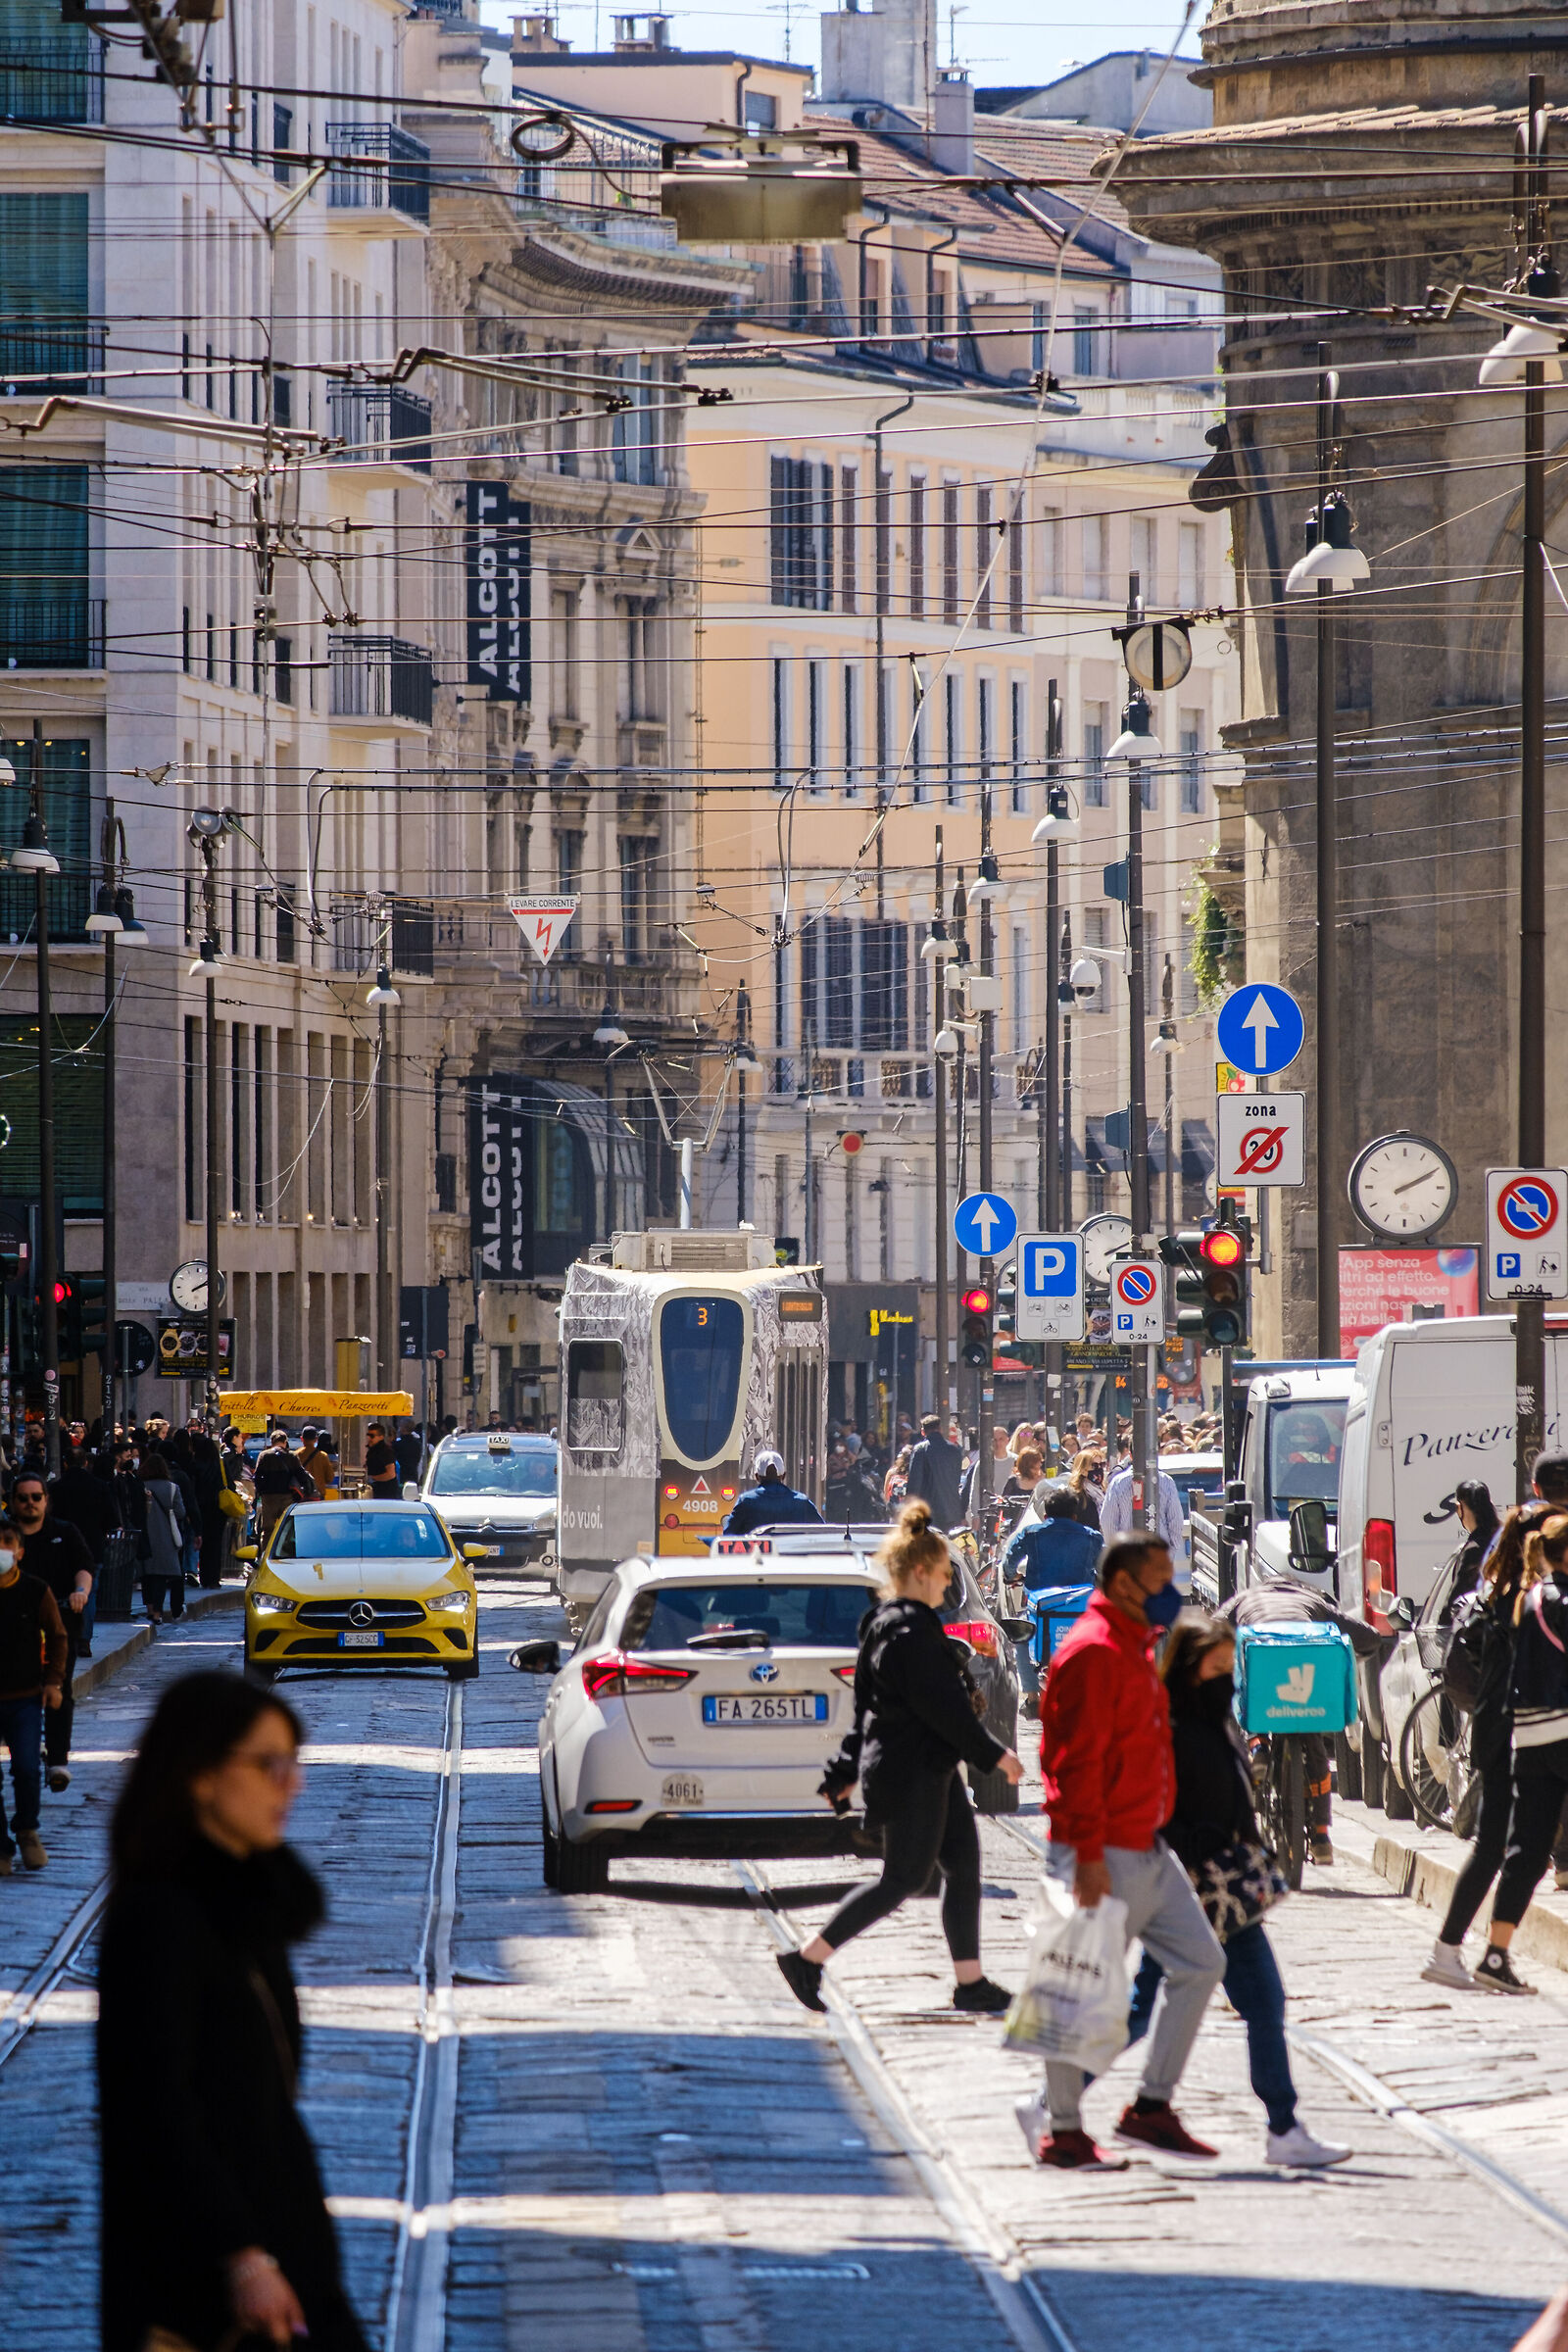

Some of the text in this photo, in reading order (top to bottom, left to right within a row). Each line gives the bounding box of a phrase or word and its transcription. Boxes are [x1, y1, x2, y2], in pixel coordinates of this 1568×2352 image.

[478, 487, 498, 678] ALCOTT
[511, 899, 575, 907] LEVARE CORRENTE
[1245, 1104, 1277, 1117] zona
[482, 1083, 502, 1272] ALCOTT
[1035, 1248, 1066, 1291] P
[1377, 1257, 1420, 1268] senza
[1501, 1255, 1516, 1275] P
[1364, 1271, 1384, 1283] ad
[1387, 1271, 1437, 1283] effetto.
[1388, 1284, 1399, 1297] le
[1403, 1284, 1450, 1297] buone
[697, 1307, 709, 1326] 3
[1359, 1311, 1396, 1324] belle
[338, 1398, 390, 1411] Panzerotti
[682, 1499, 718, 1514] 4908
[577, 1504, 604, 1530] vuoi.
[718, 1541, 769, 1554] TAXI
[718, 1698, 813, 1720] FA 265TL
[1265, 1704, 1326, 1718] deliveroo
[667, 1783, 697, 1798] 4061
